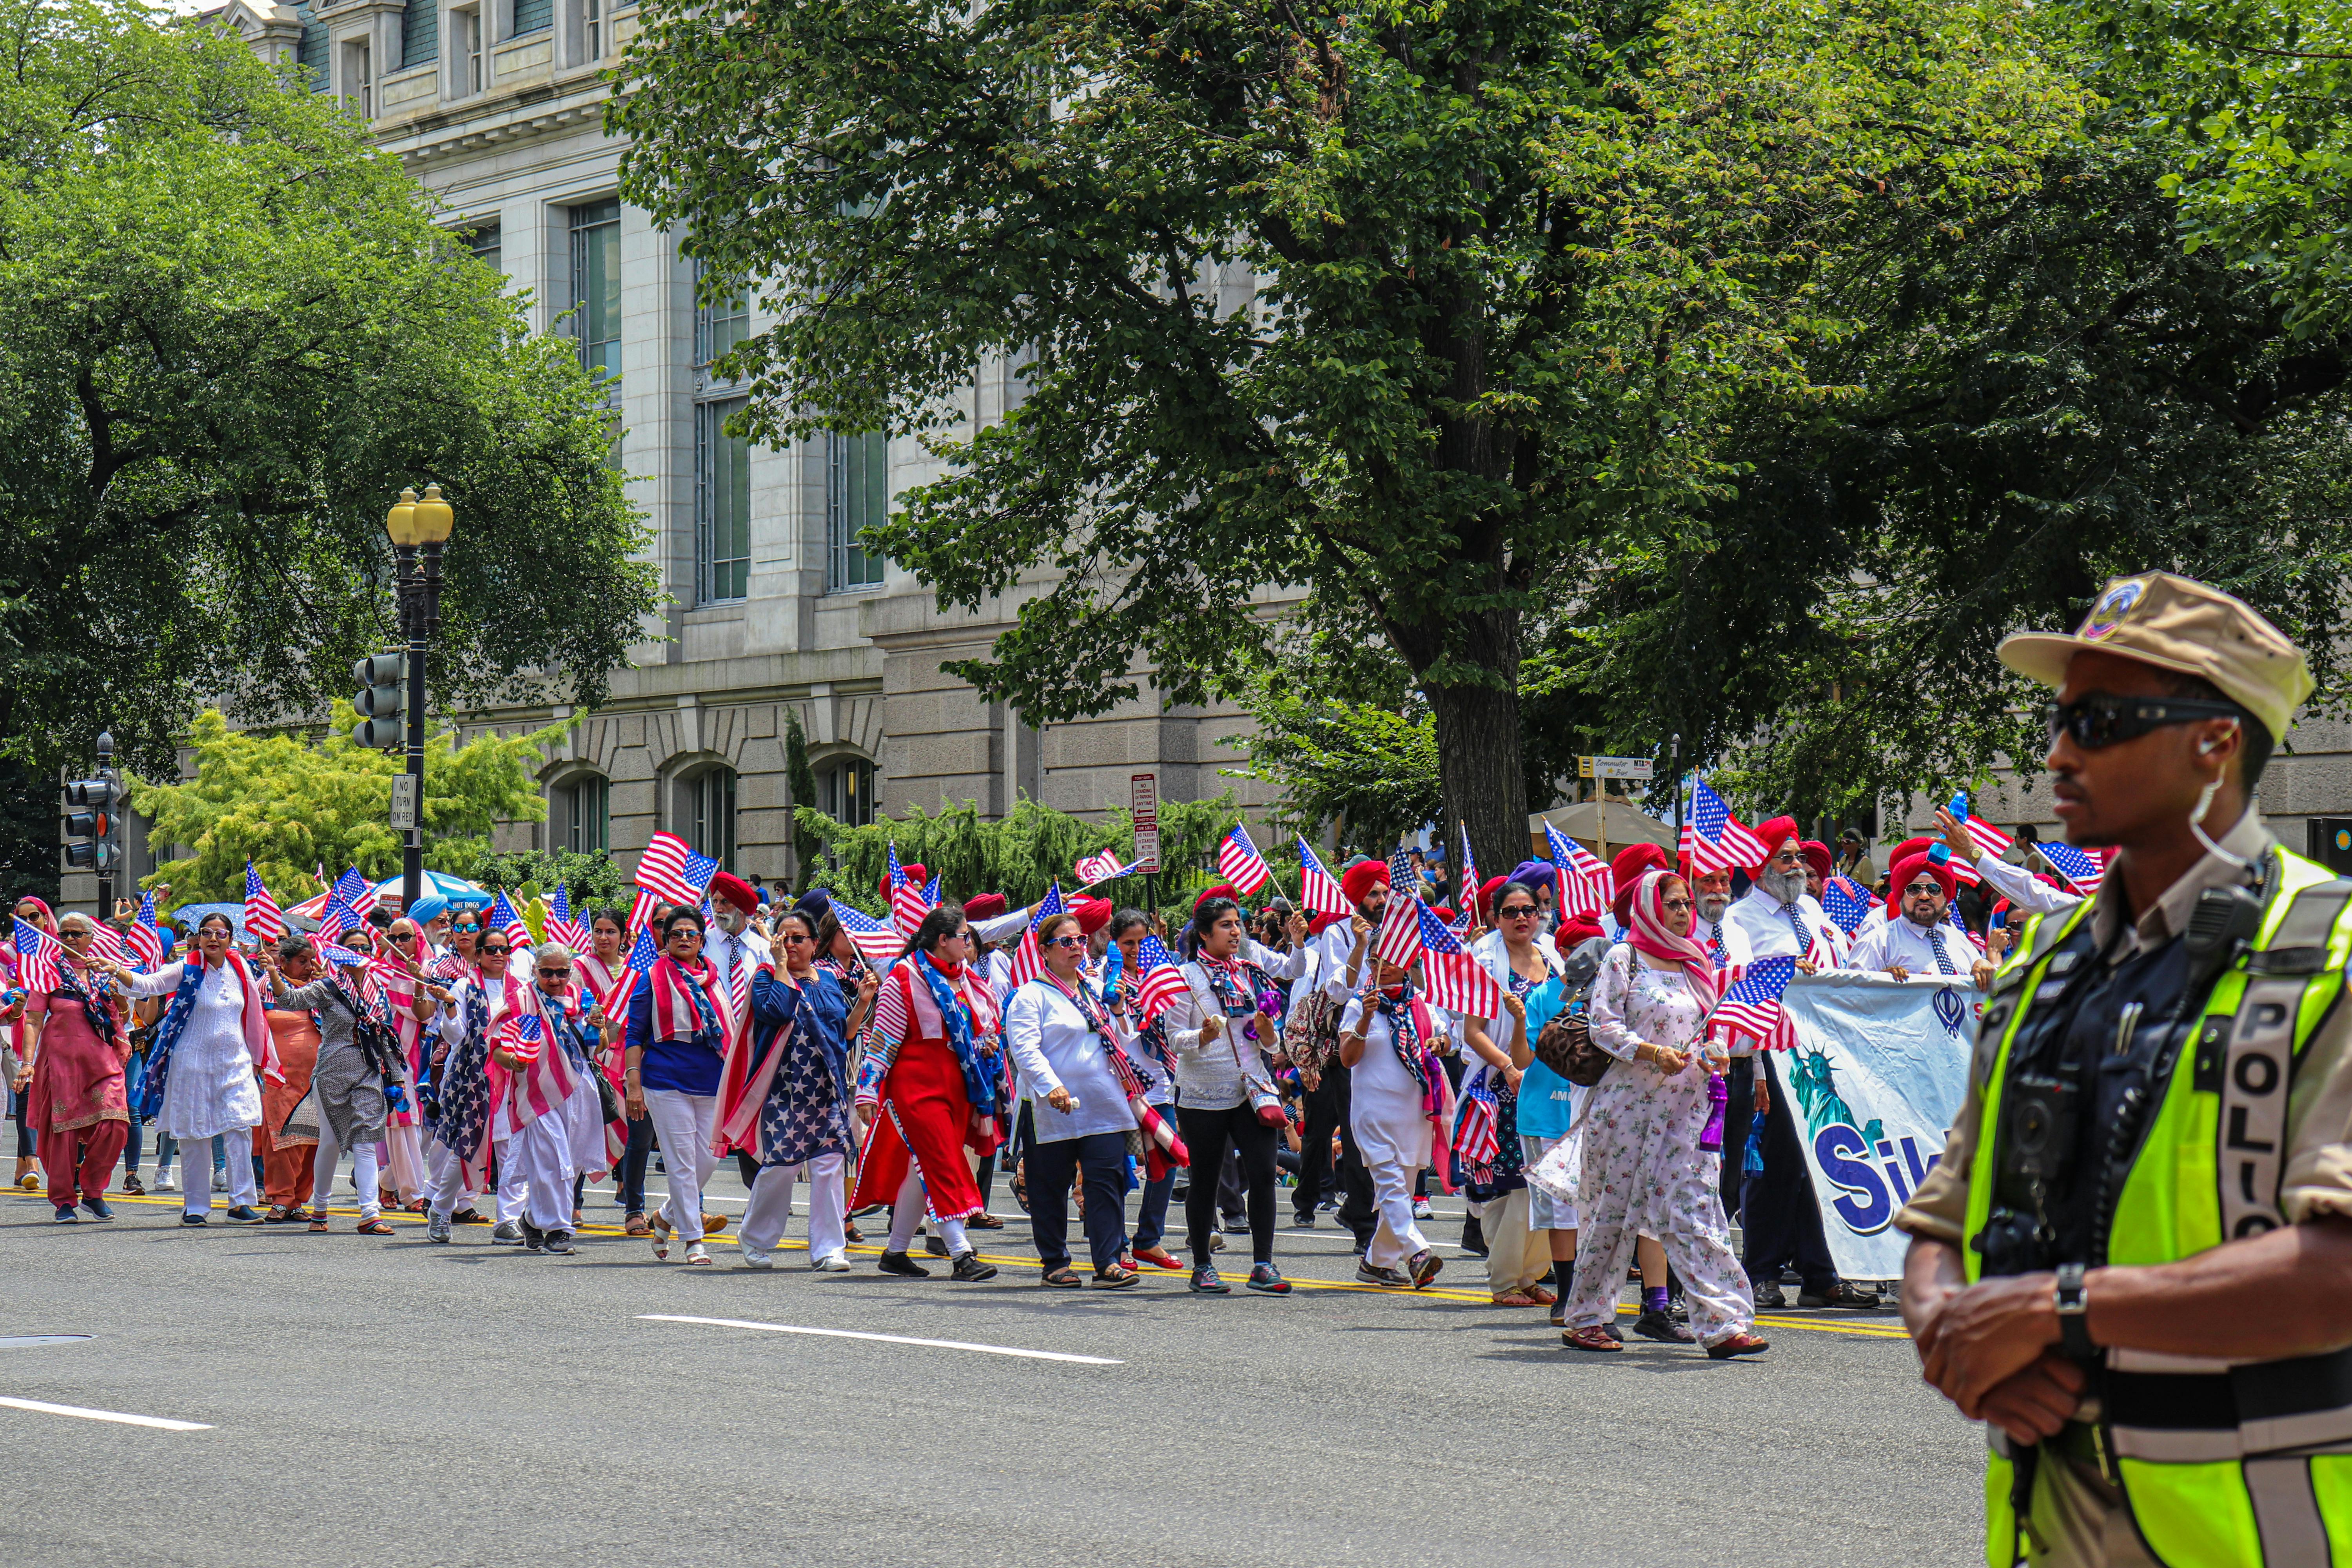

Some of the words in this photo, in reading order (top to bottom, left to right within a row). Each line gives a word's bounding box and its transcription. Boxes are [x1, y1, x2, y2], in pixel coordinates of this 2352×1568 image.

[1596, 759, 1628, 767] Commuter
[399, 781, 408, 791] NO
[396, 796, 410, 807] TURN
[392, 811, 400, 822] ON
[402, 812, 412, 822] RED
[1814, 1122, 1951, 1233] Sik
